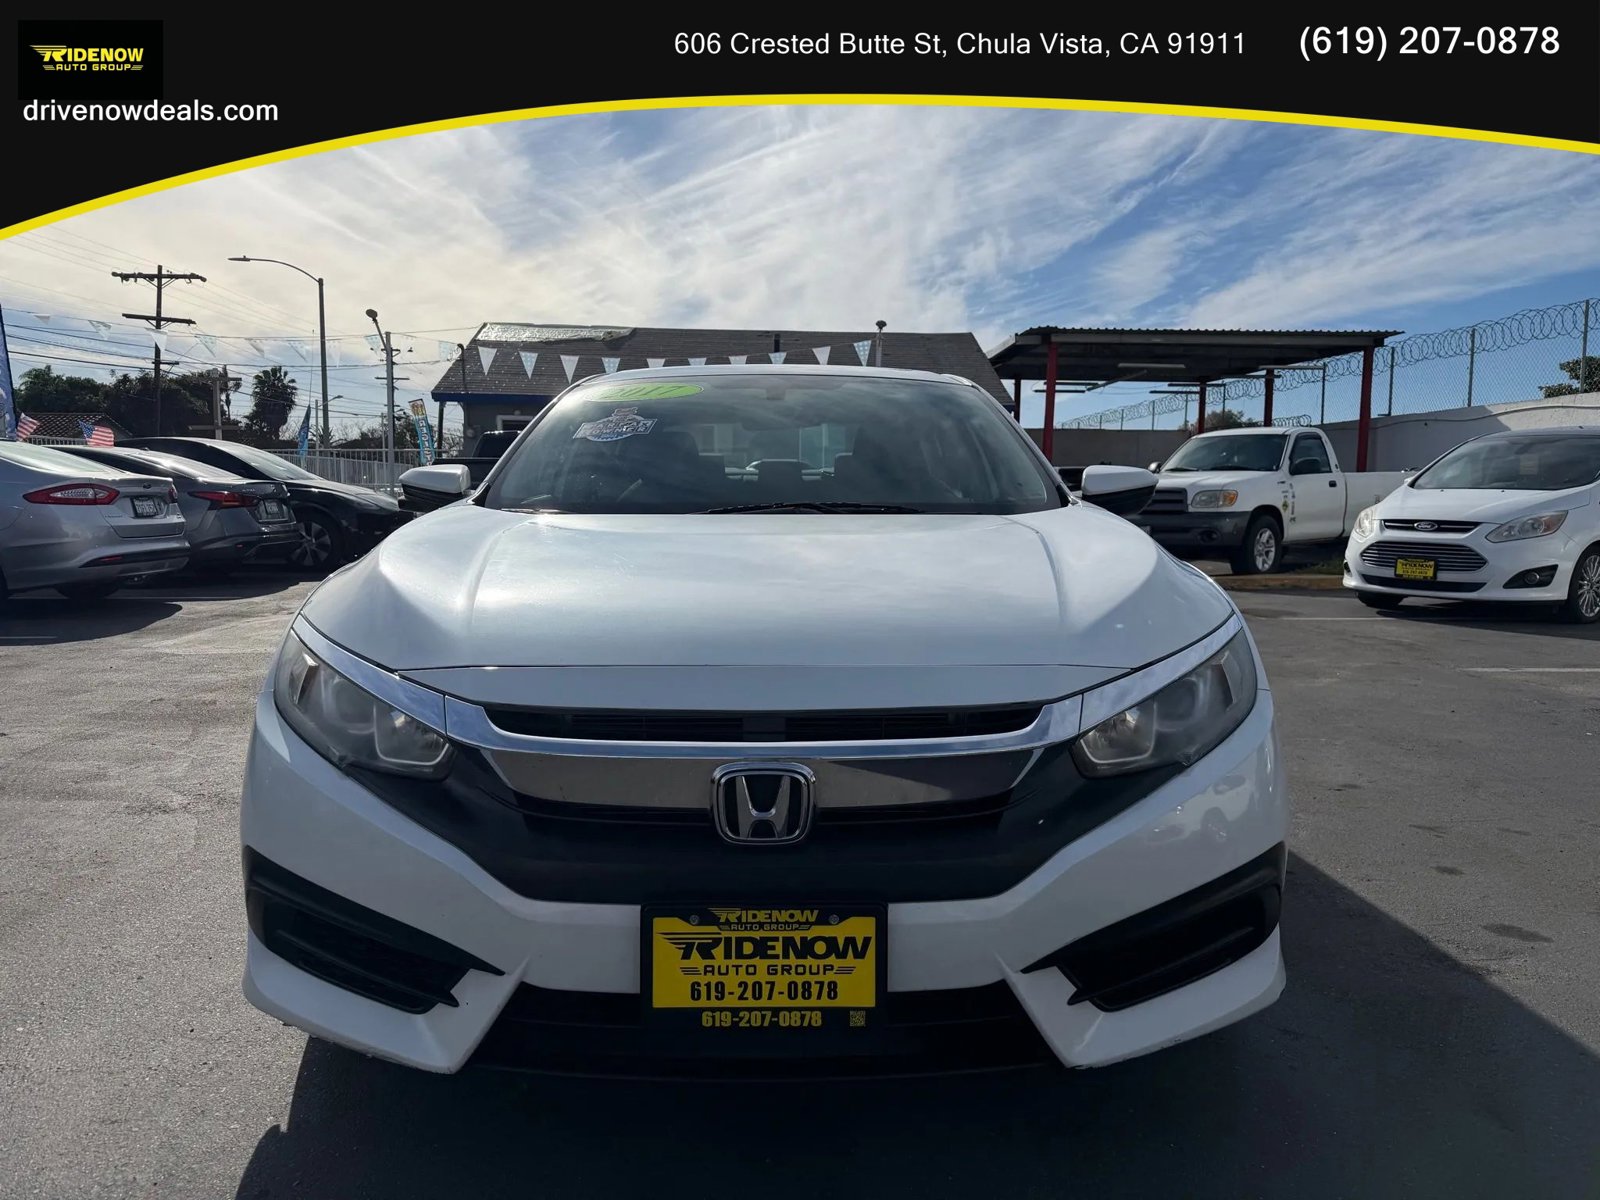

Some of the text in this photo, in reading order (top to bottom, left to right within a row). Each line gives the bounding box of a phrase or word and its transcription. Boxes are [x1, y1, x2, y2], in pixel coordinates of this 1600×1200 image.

[708, 908, 819, 923] RIDENOW
[657, 932, 872, 960] RIDENOW
[703, 964, 835, 976] AUTO GROUP
[690, 981, 839, 1001] 619-207-0878
[701, 1011, 822, 1027] 619-207-0878
